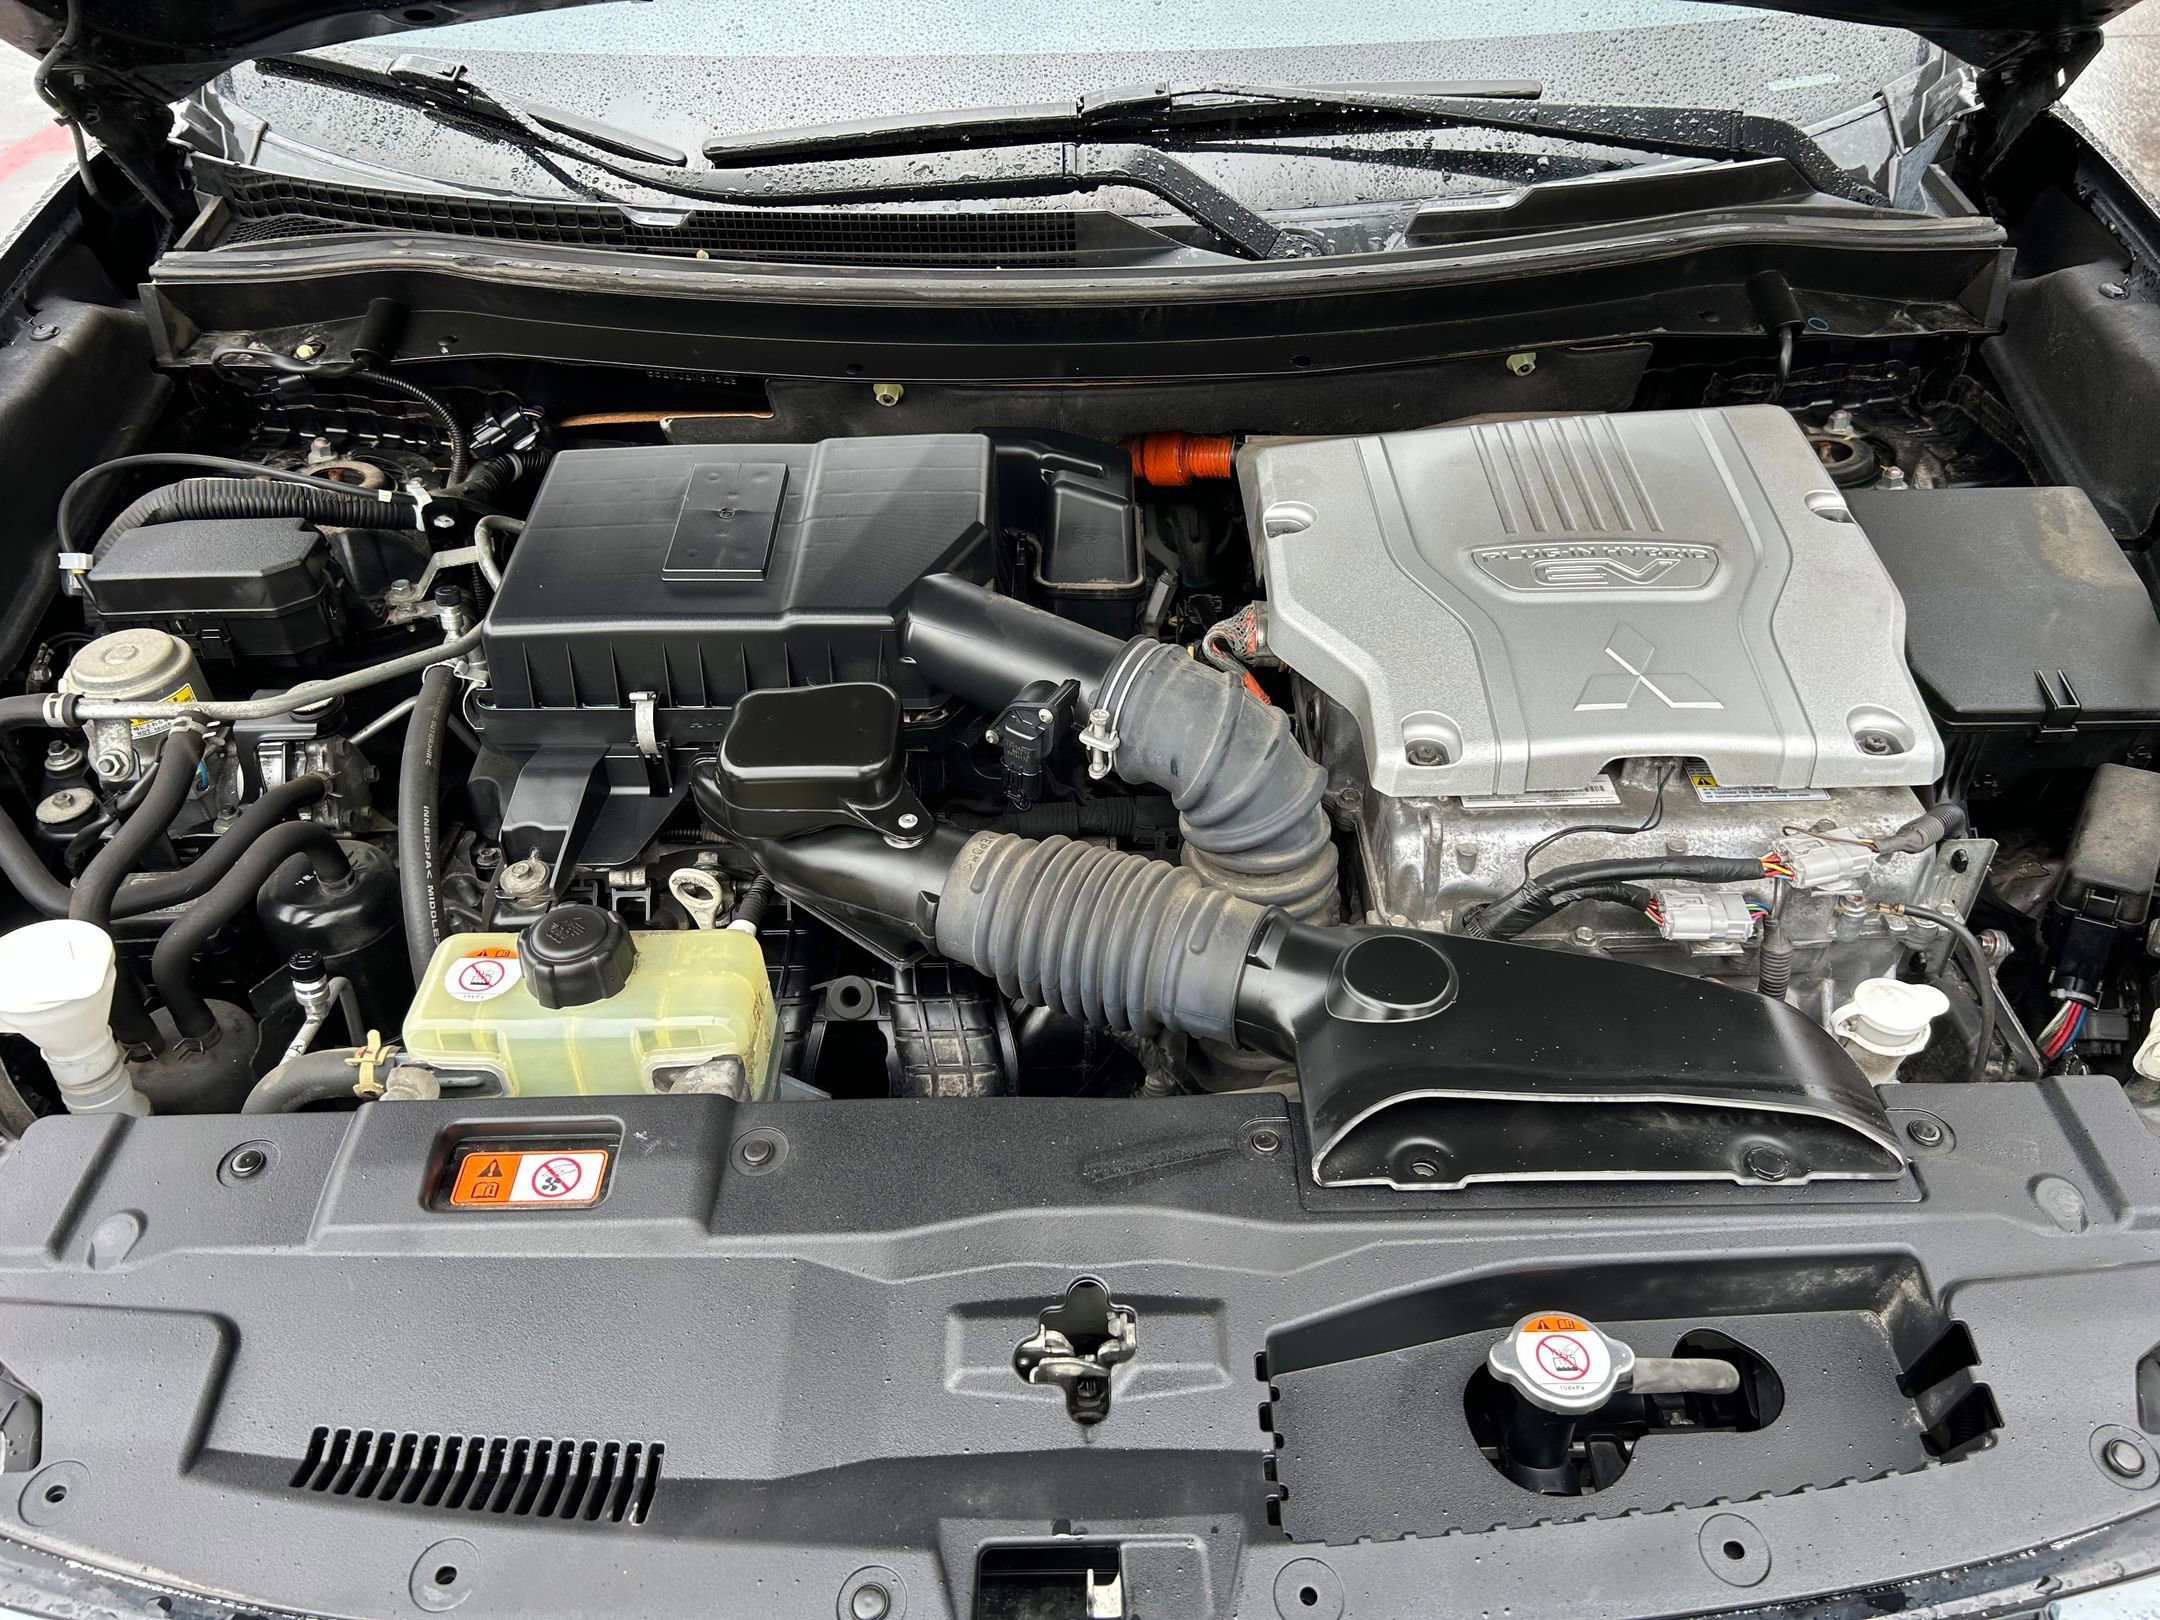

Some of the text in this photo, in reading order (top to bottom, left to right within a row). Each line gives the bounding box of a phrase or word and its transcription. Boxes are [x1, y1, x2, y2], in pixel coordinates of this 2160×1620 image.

[1481, 546, 1710, 562] PLUG-IN HYBRID
[1530, 557, 1682, 586] EV
